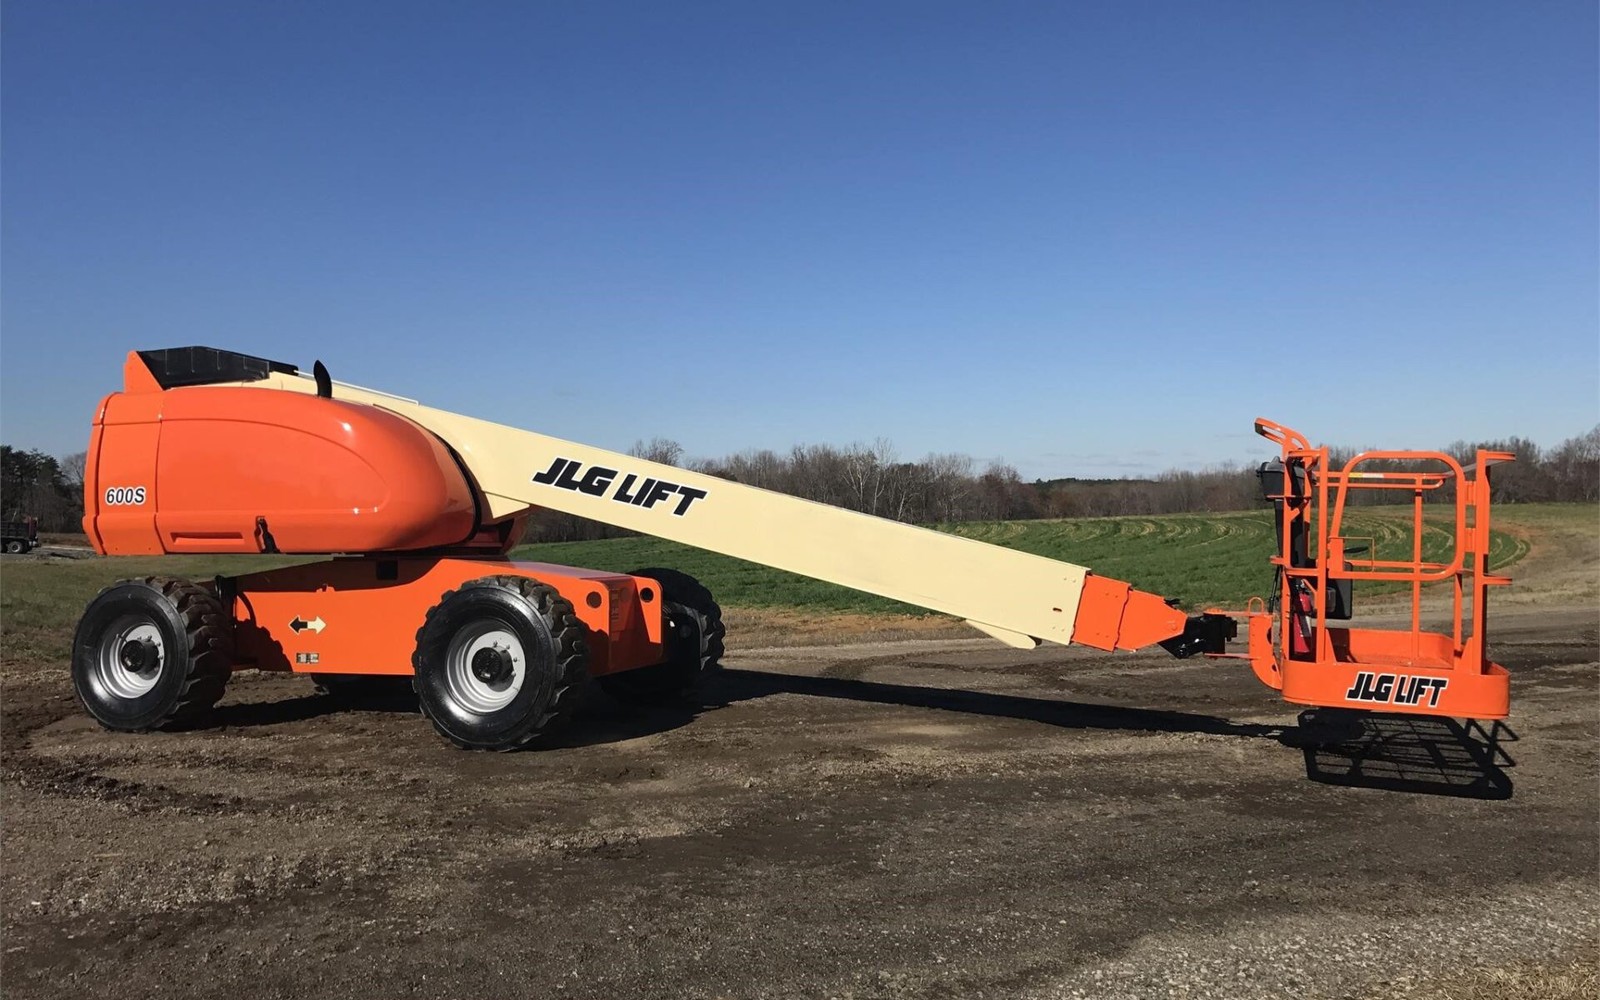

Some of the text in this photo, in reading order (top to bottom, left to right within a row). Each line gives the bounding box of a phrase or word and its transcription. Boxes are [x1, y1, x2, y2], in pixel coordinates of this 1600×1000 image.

[106, 487, 145, 505] 600S
[532, 457, 708, 516] JLG LIFT
[1346, 672, 1448, 707] JLG LIFT
